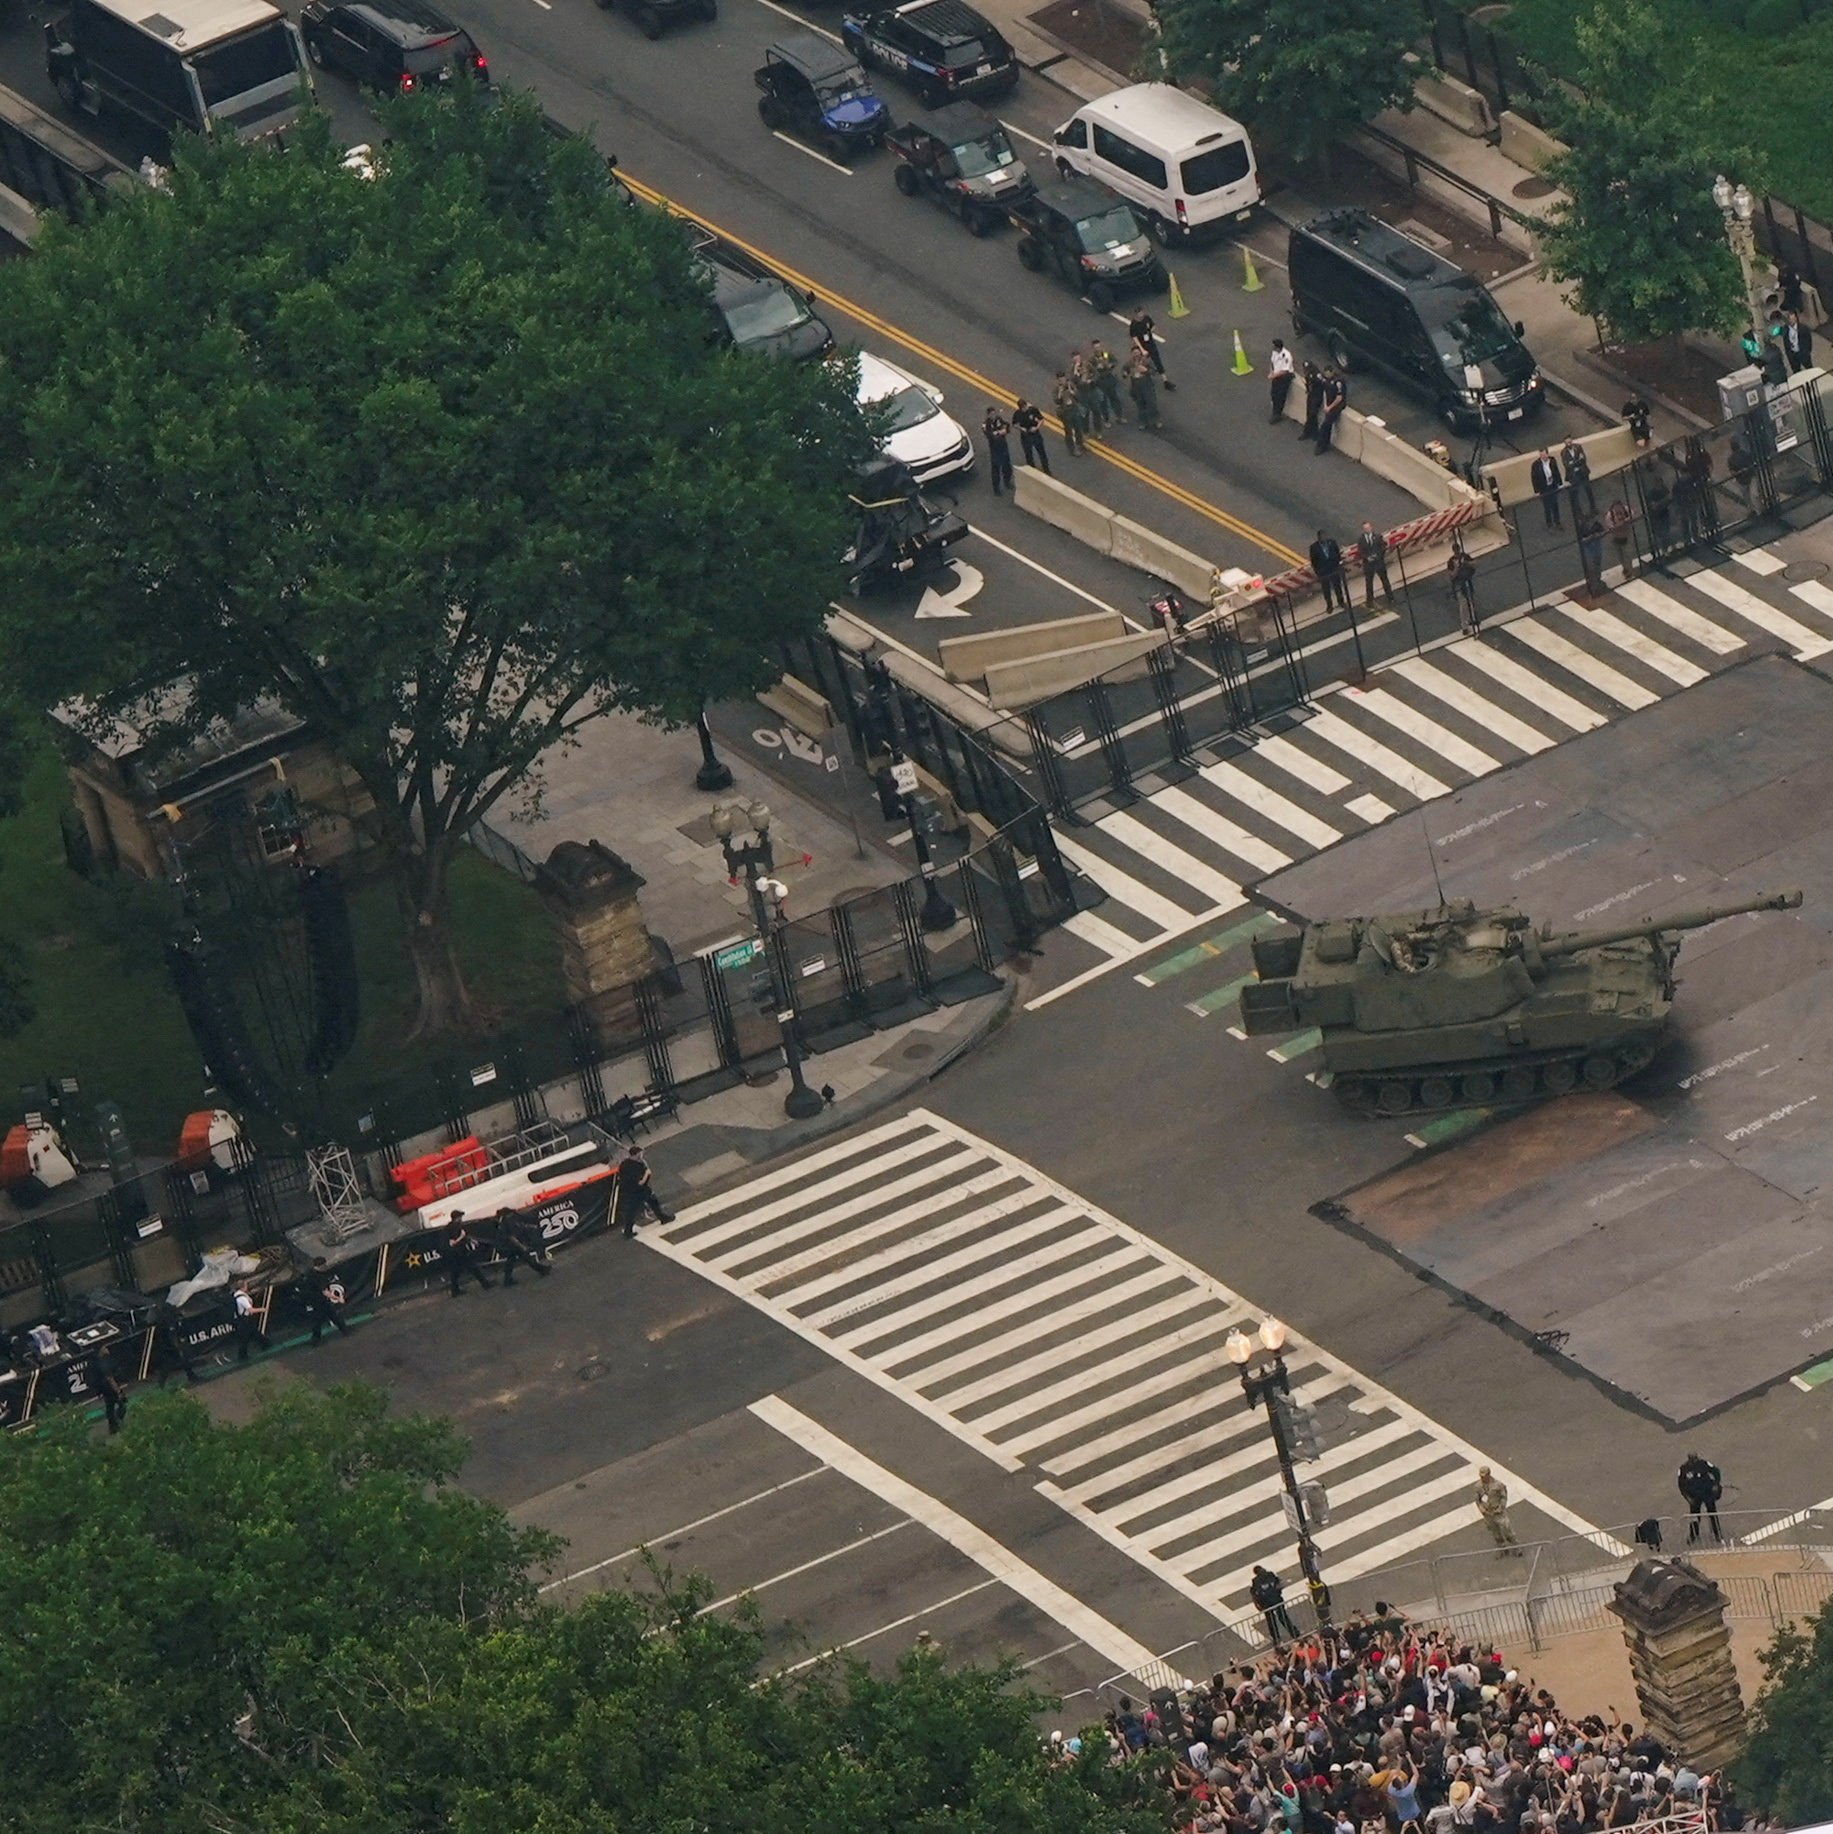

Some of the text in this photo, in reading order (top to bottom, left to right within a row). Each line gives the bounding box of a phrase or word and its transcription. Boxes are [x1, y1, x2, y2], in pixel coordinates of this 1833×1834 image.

[537, 1200, 574, 1219] AMERICA
[539, 1209, 579, 1239] 250
[189, 1330, 209, 1345] U.S.
